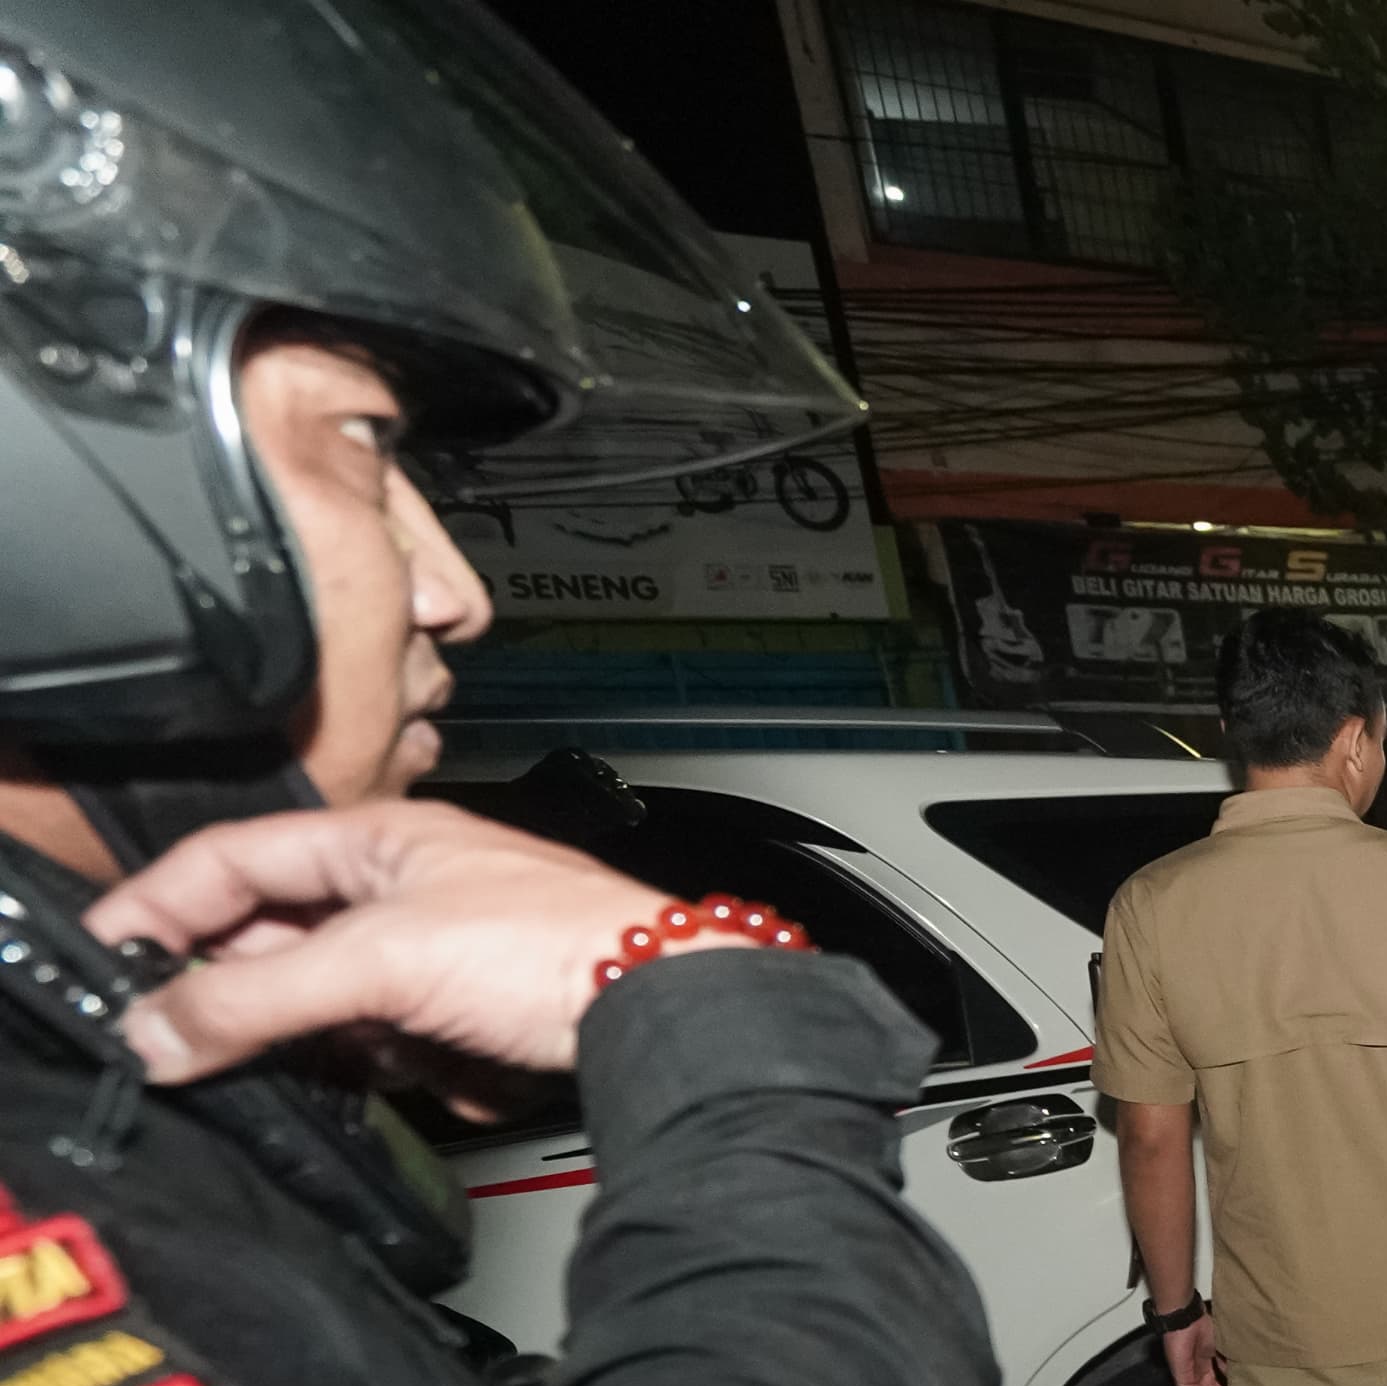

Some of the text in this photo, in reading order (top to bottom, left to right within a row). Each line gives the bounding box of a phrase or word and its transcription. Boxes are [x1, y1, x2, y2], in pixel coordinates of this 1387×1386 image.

[508, 573, 660, 602] SENENG
[1072, 575, 1116, 596] BELI
[1122, 578, 1183, 599] GITAR
[1187, 582, 1264, 603] SATUAN
[1268, 585, 1330, 606] HARGA
